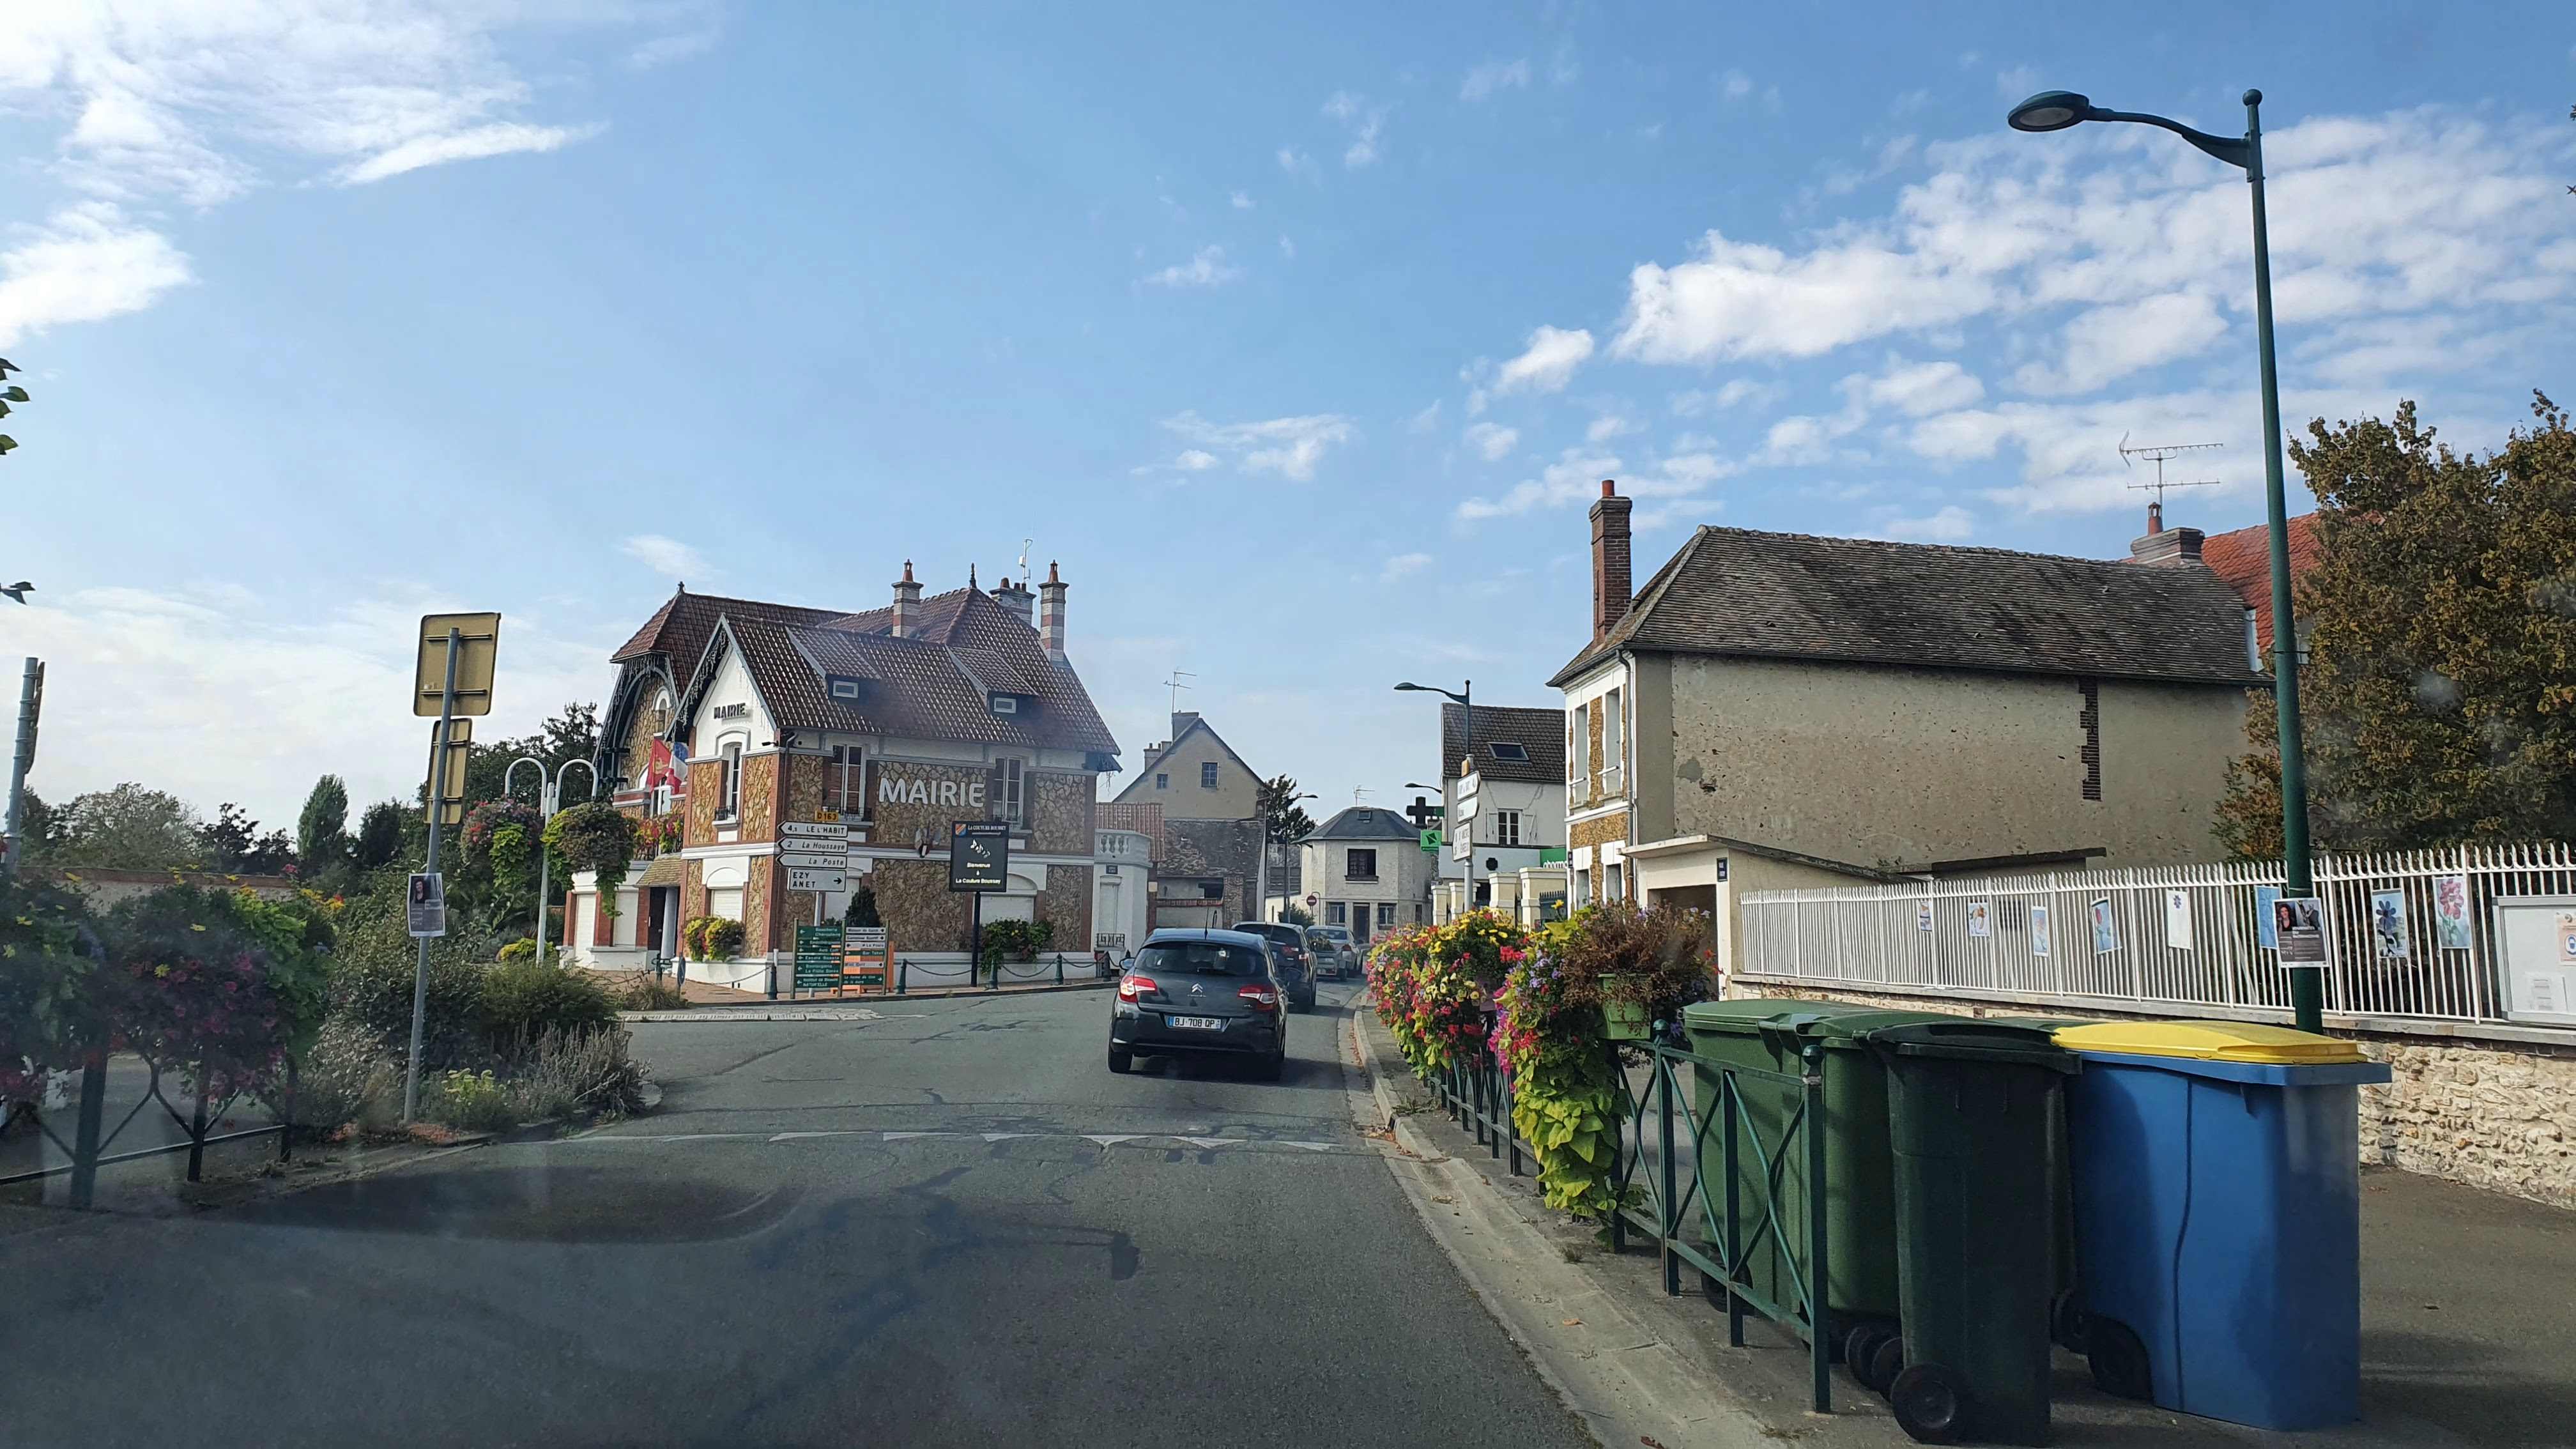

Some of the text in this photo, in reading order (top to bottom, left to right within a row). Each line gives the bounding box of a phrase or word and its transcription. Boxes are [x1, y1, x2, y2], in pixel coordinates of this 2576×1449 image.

[714, 703, 746, 719] MAIRIE
[878, 778, 985, 808] MAIRIE
[813, 843, 845, 851] Houssaye
